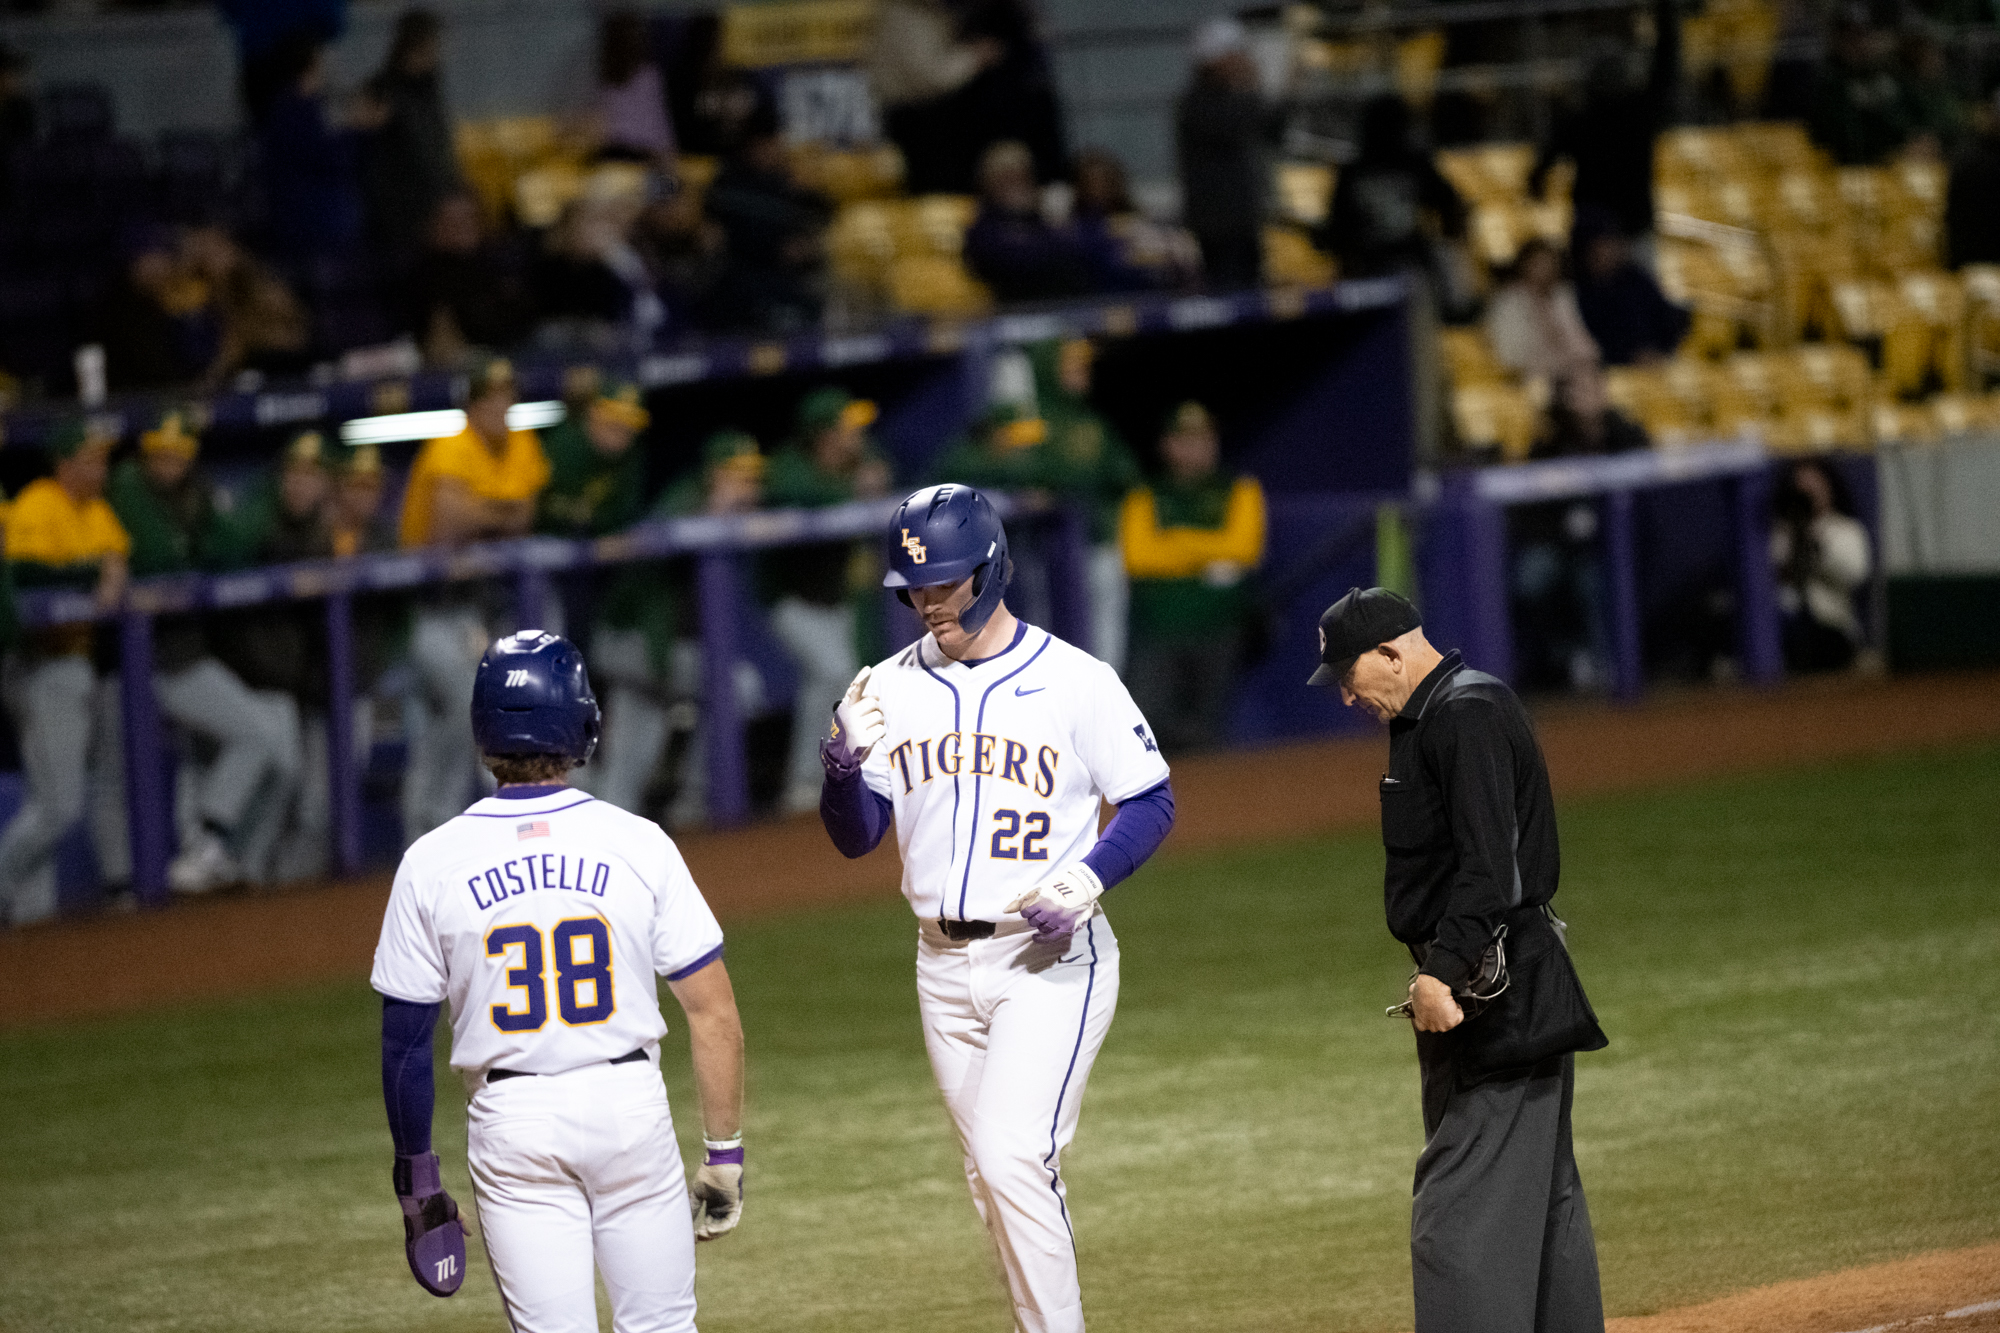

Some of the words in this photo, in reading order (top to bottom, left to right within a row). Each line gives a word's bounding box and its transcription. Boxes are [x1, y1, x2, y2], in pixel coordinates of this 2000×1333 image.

[902, 528, 927, 564] LSU
[889, 732, 1059, 799] TIGERS
[990, 808, 1051, 862] 22
[468, 853, 610, 911] COSTELLO
[483, 914, 617, 1035] 38
